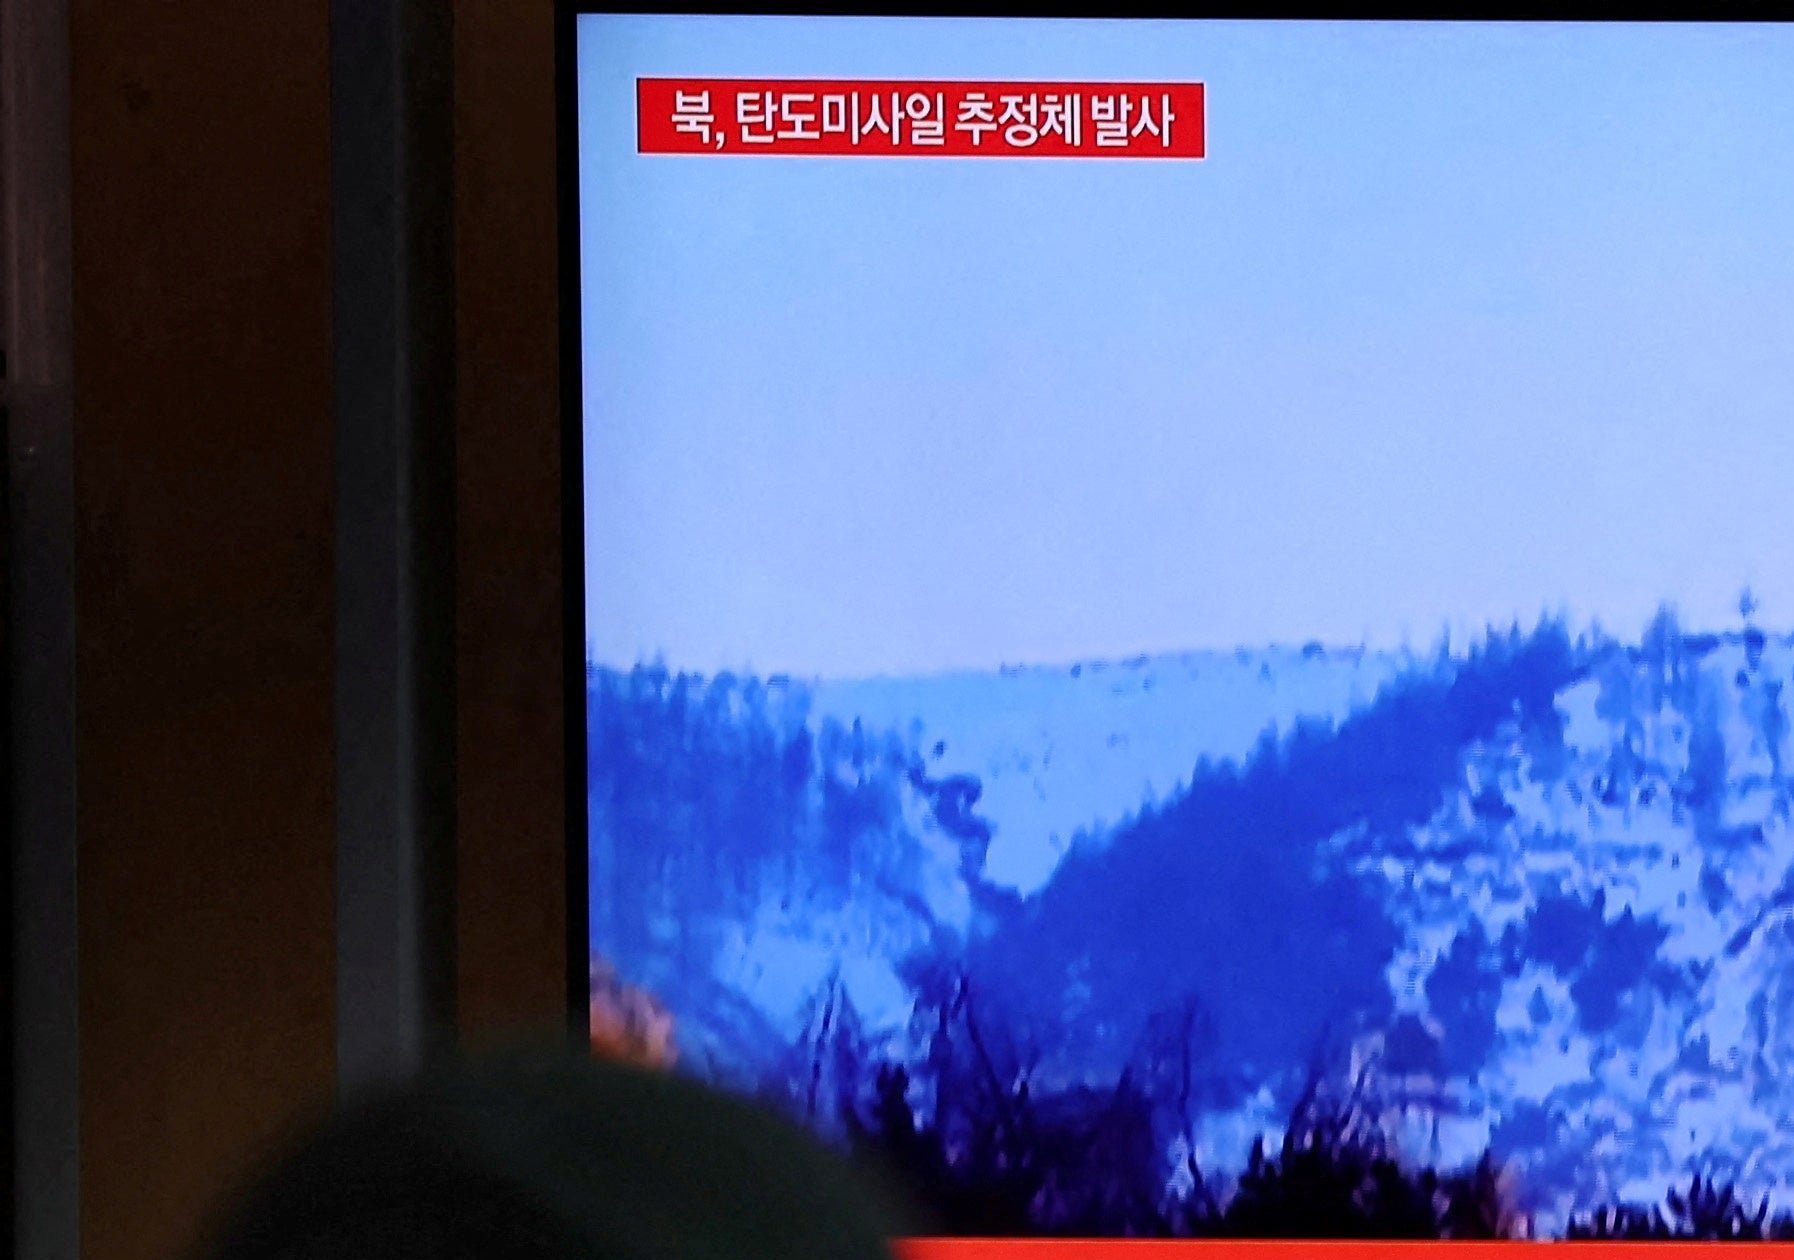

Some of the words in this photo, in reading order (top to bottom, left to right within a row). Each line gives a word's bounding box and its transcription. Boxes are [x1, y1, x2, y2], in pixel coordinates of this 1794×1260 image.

[671, 90, 725, 150] 북,
[736, 91, 946, 146] 탄도미사일
[953, 92, 1082, 148] 추정체
[1090, 93, 1175, 148] 발사
